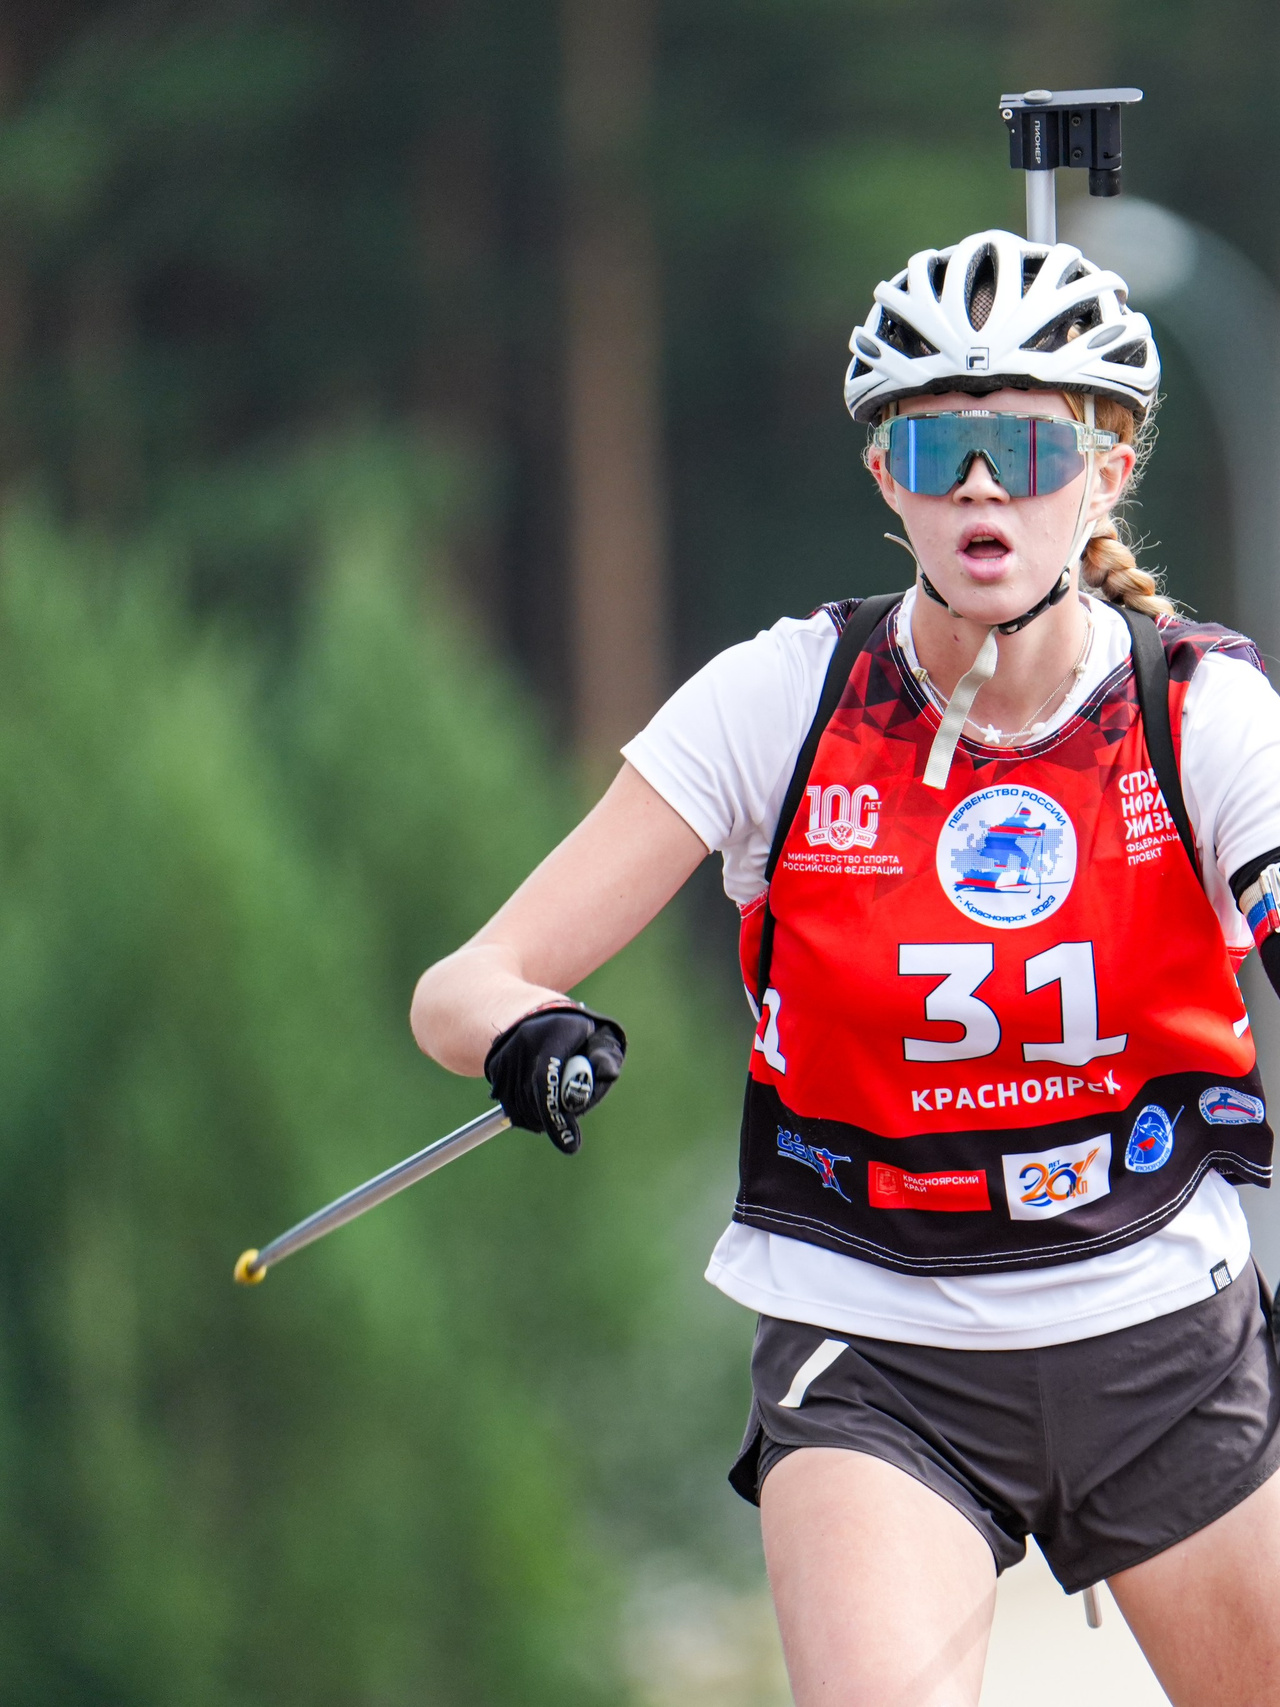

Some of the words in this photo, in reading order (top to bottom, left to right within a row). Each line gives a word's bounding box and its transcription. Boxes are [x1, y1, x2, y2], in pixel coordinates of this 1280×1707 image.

[1118, 768, 1157, 794] СПОР
[806, 784, 879, 834] 100
[863, 801, 882, 811] ЛЕТ
[948, 788, 1019, 828] ПЕРВЕНСТВО
[1021, 788, 1066, 826] РОССИИ
[1121, 789, 1168, 818] НОР
[1124, 811, 1174, 840] ЖИЗН
[1126, 833, 1181, 853] ФЕДЕРАЛЬН
[783, 861, 842, 873] РОССИЙСКОЙ
[844, 865, 903, 875] ФЕДЕРАЦИИ
[787, 852, 861, 864] МИНИСТЕРСТВО
[863, 855, 899, 864] СПОРТА
[1128, 847, 1162, 866] ПРОЕКТ
[964, 900, 1027, 923] Красноярск
[1031, 895, 1056, 916] 2023
[898, 940, 1129, 1067] 31
[911, 1069, 1121, 1112] КРАСНОЯРСК
[903, 1174, 979, 1186] КРАСНОЯРСКИЙ
[904, 1183, 927, 1193] КРАЙ
